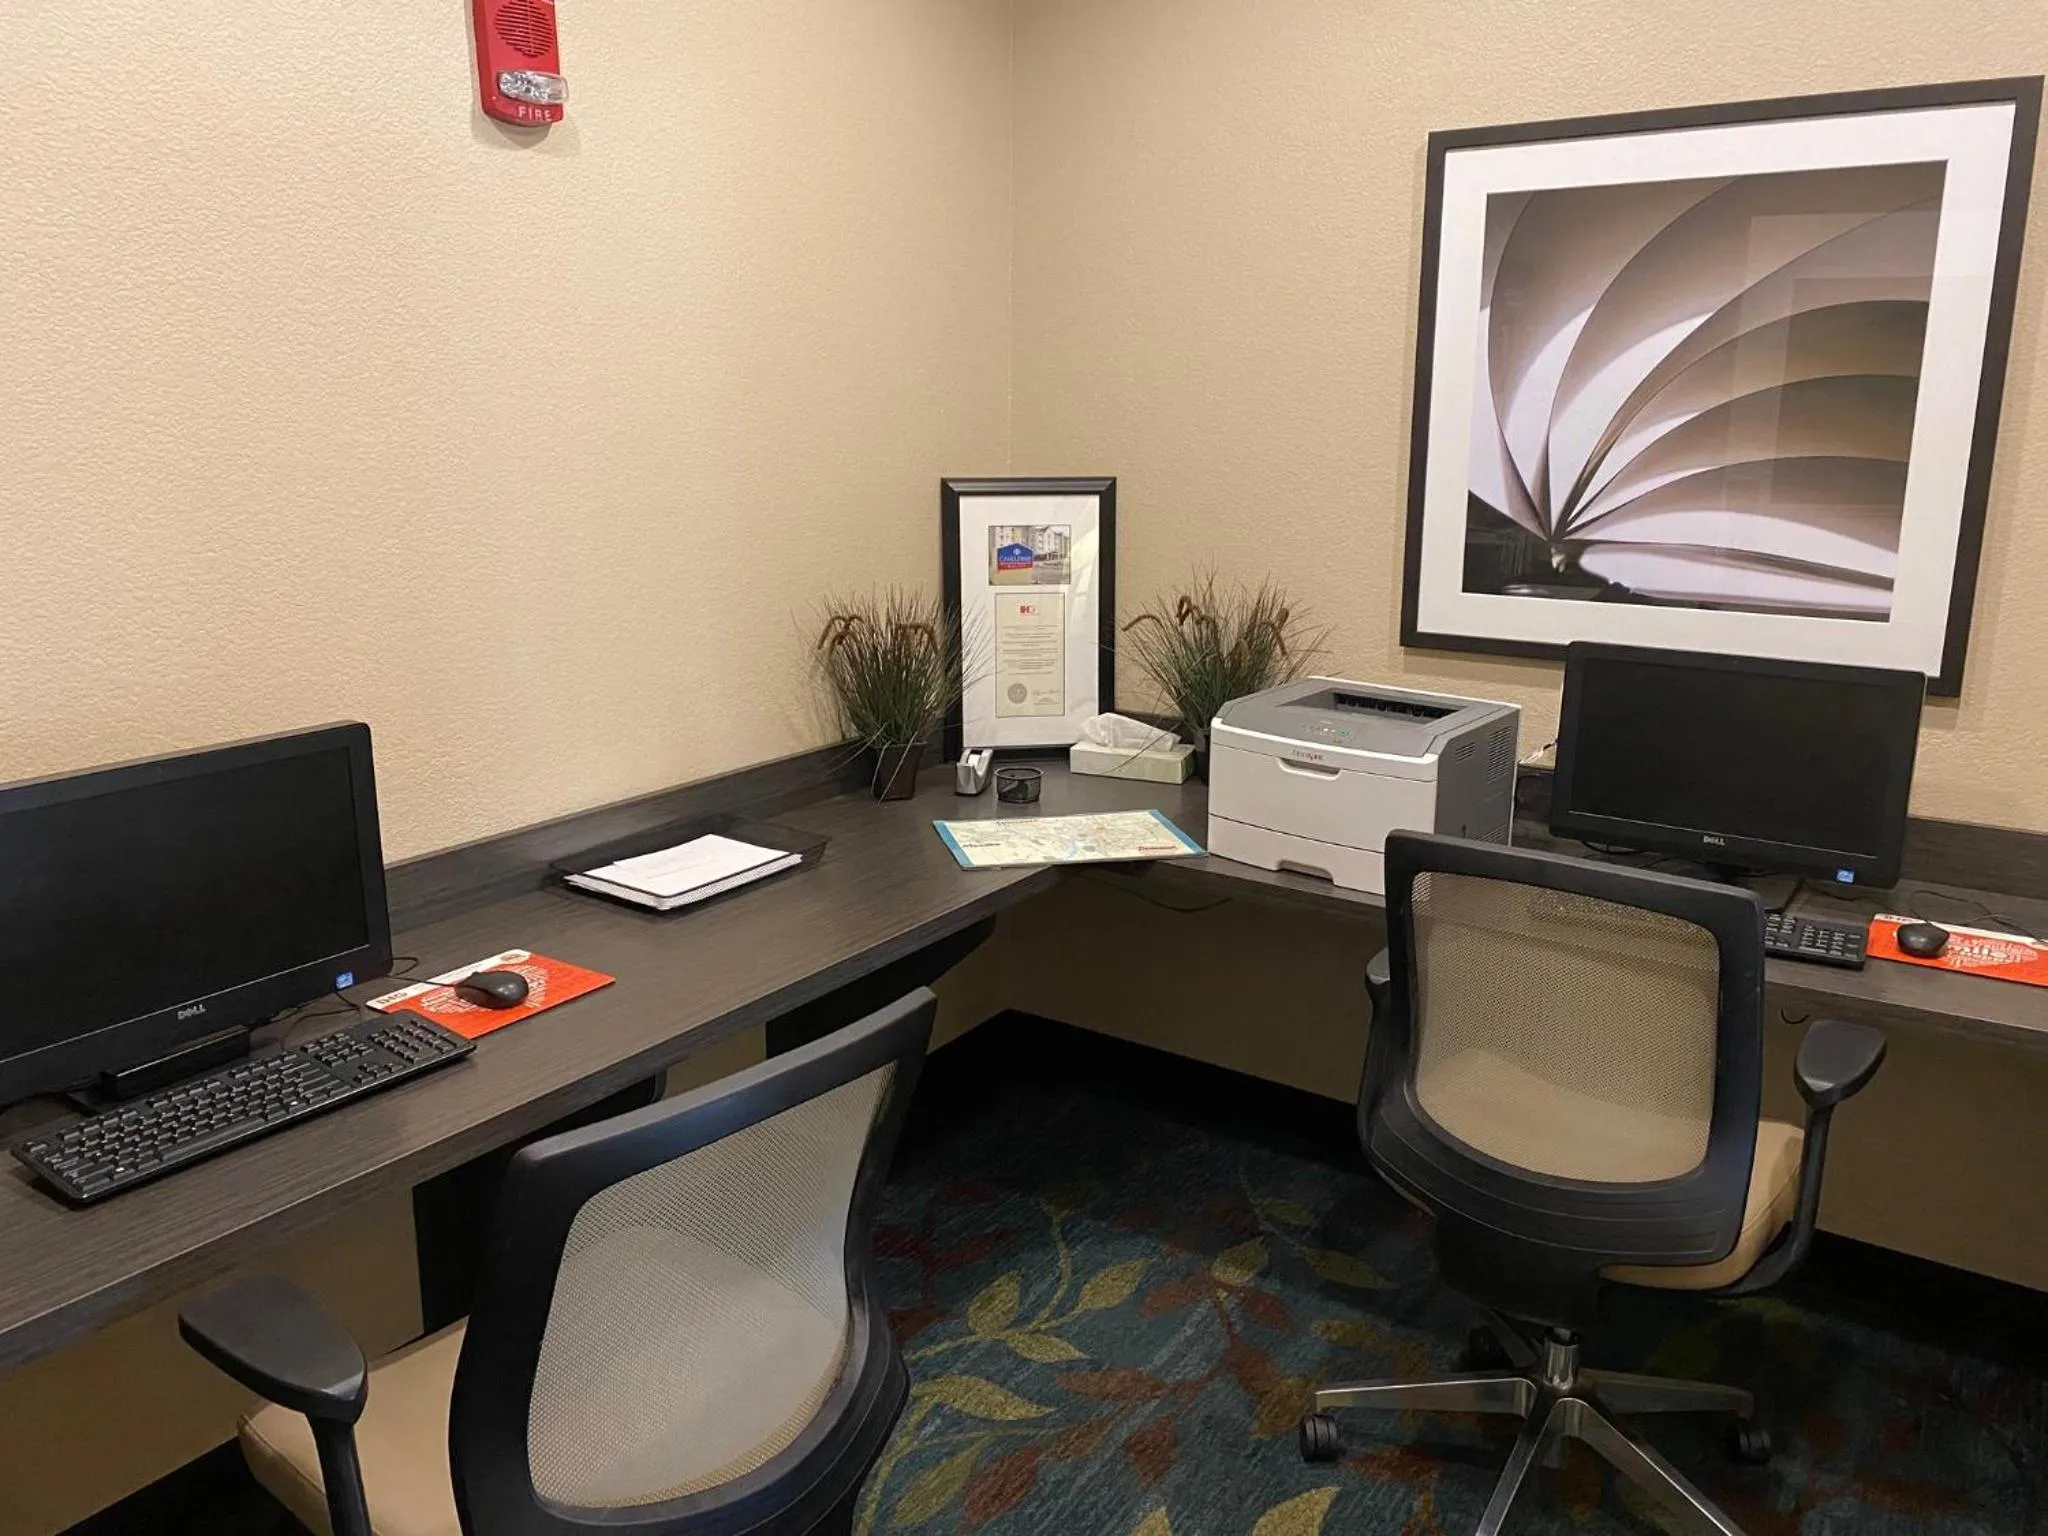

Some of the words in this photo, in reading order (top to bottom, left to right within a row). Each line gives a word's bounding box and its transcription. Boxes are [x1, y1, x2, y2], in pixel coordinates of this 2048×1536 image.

[518, 106, 552, 121] FIRE
[1703, 835, 1726, 846] DELL
[177, 1004, 206, 1020] DELL
